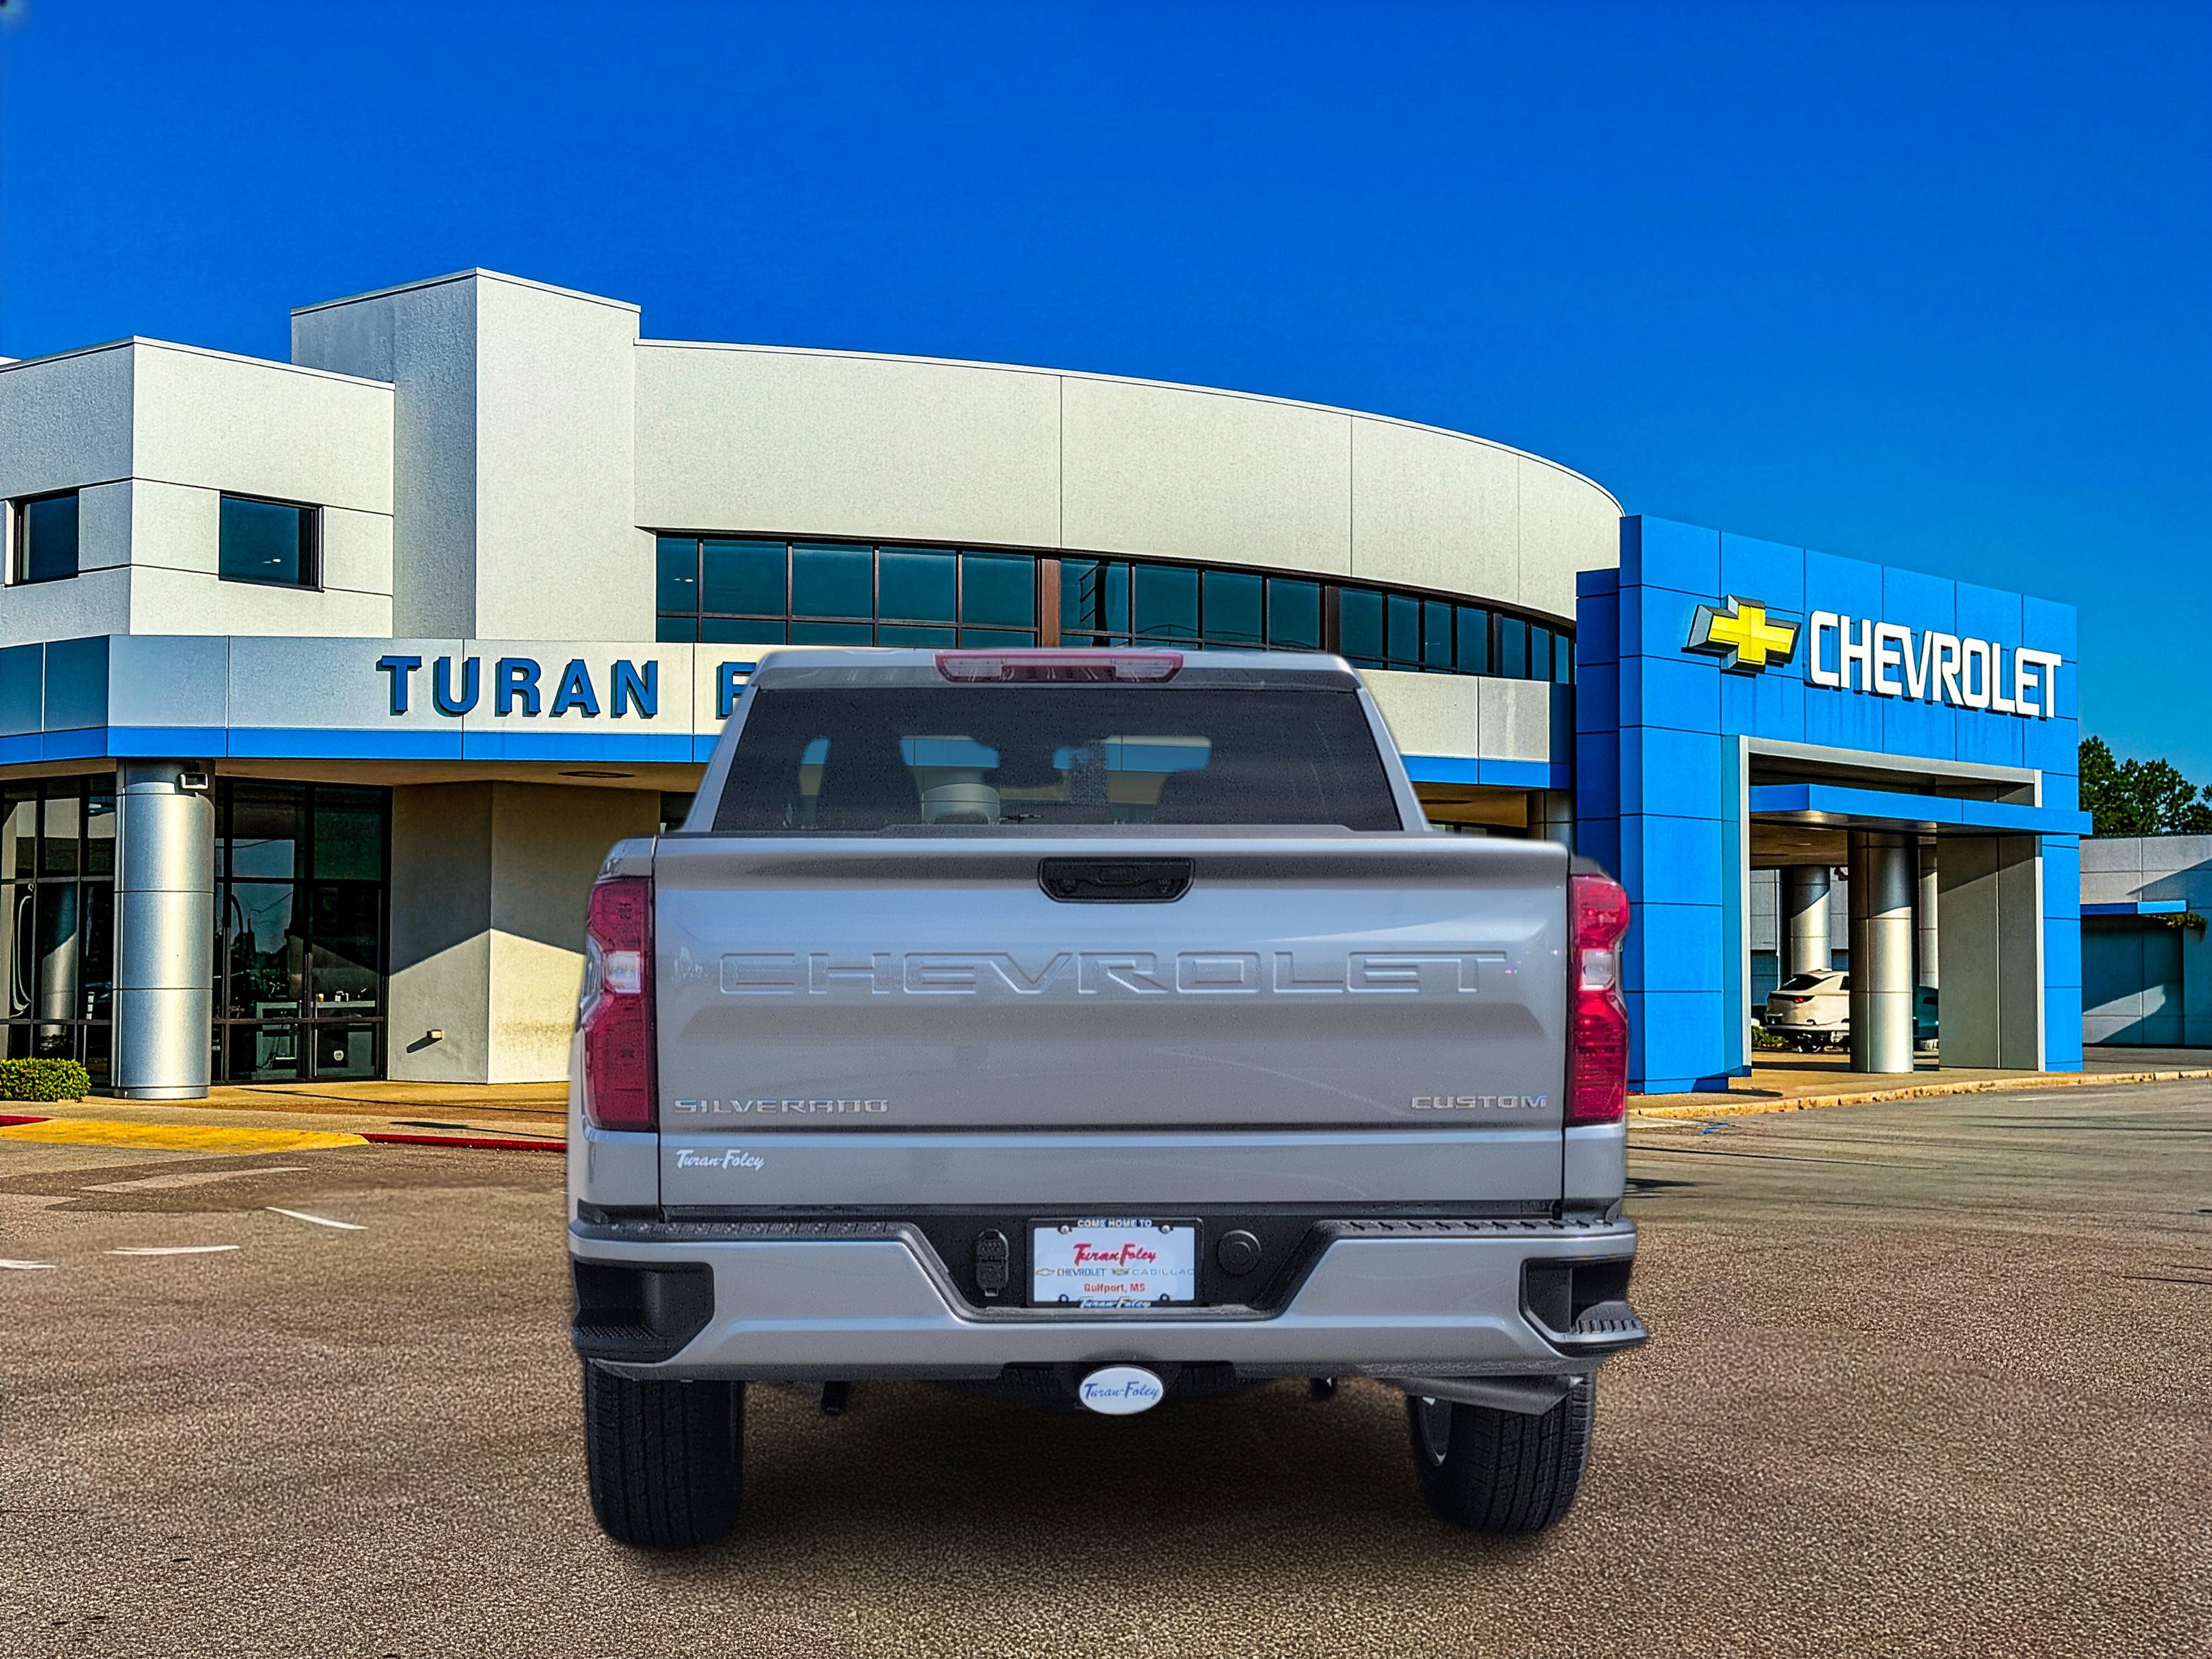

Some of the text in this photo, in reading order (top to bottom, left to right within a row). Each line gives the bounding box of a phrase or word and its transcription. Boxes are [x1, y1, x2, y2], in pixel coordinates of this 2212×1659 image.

[1810, 610, 2062, 718] CHEVROLET
[376, 654, 659, 718] TURAN
[719, 951, 1507, 994] CHEVROLET
[674, 1098, 889, 1114] SILVERADO
[1411, 1094, 1548, 1109] CUSTOM
[1077, 1218, 1153, 1227] COME HOME TO
[1057, 1268, 1107, 1276] CHEVROLET
[1084, 1283, 1146, 1294] Gulfport, MS
